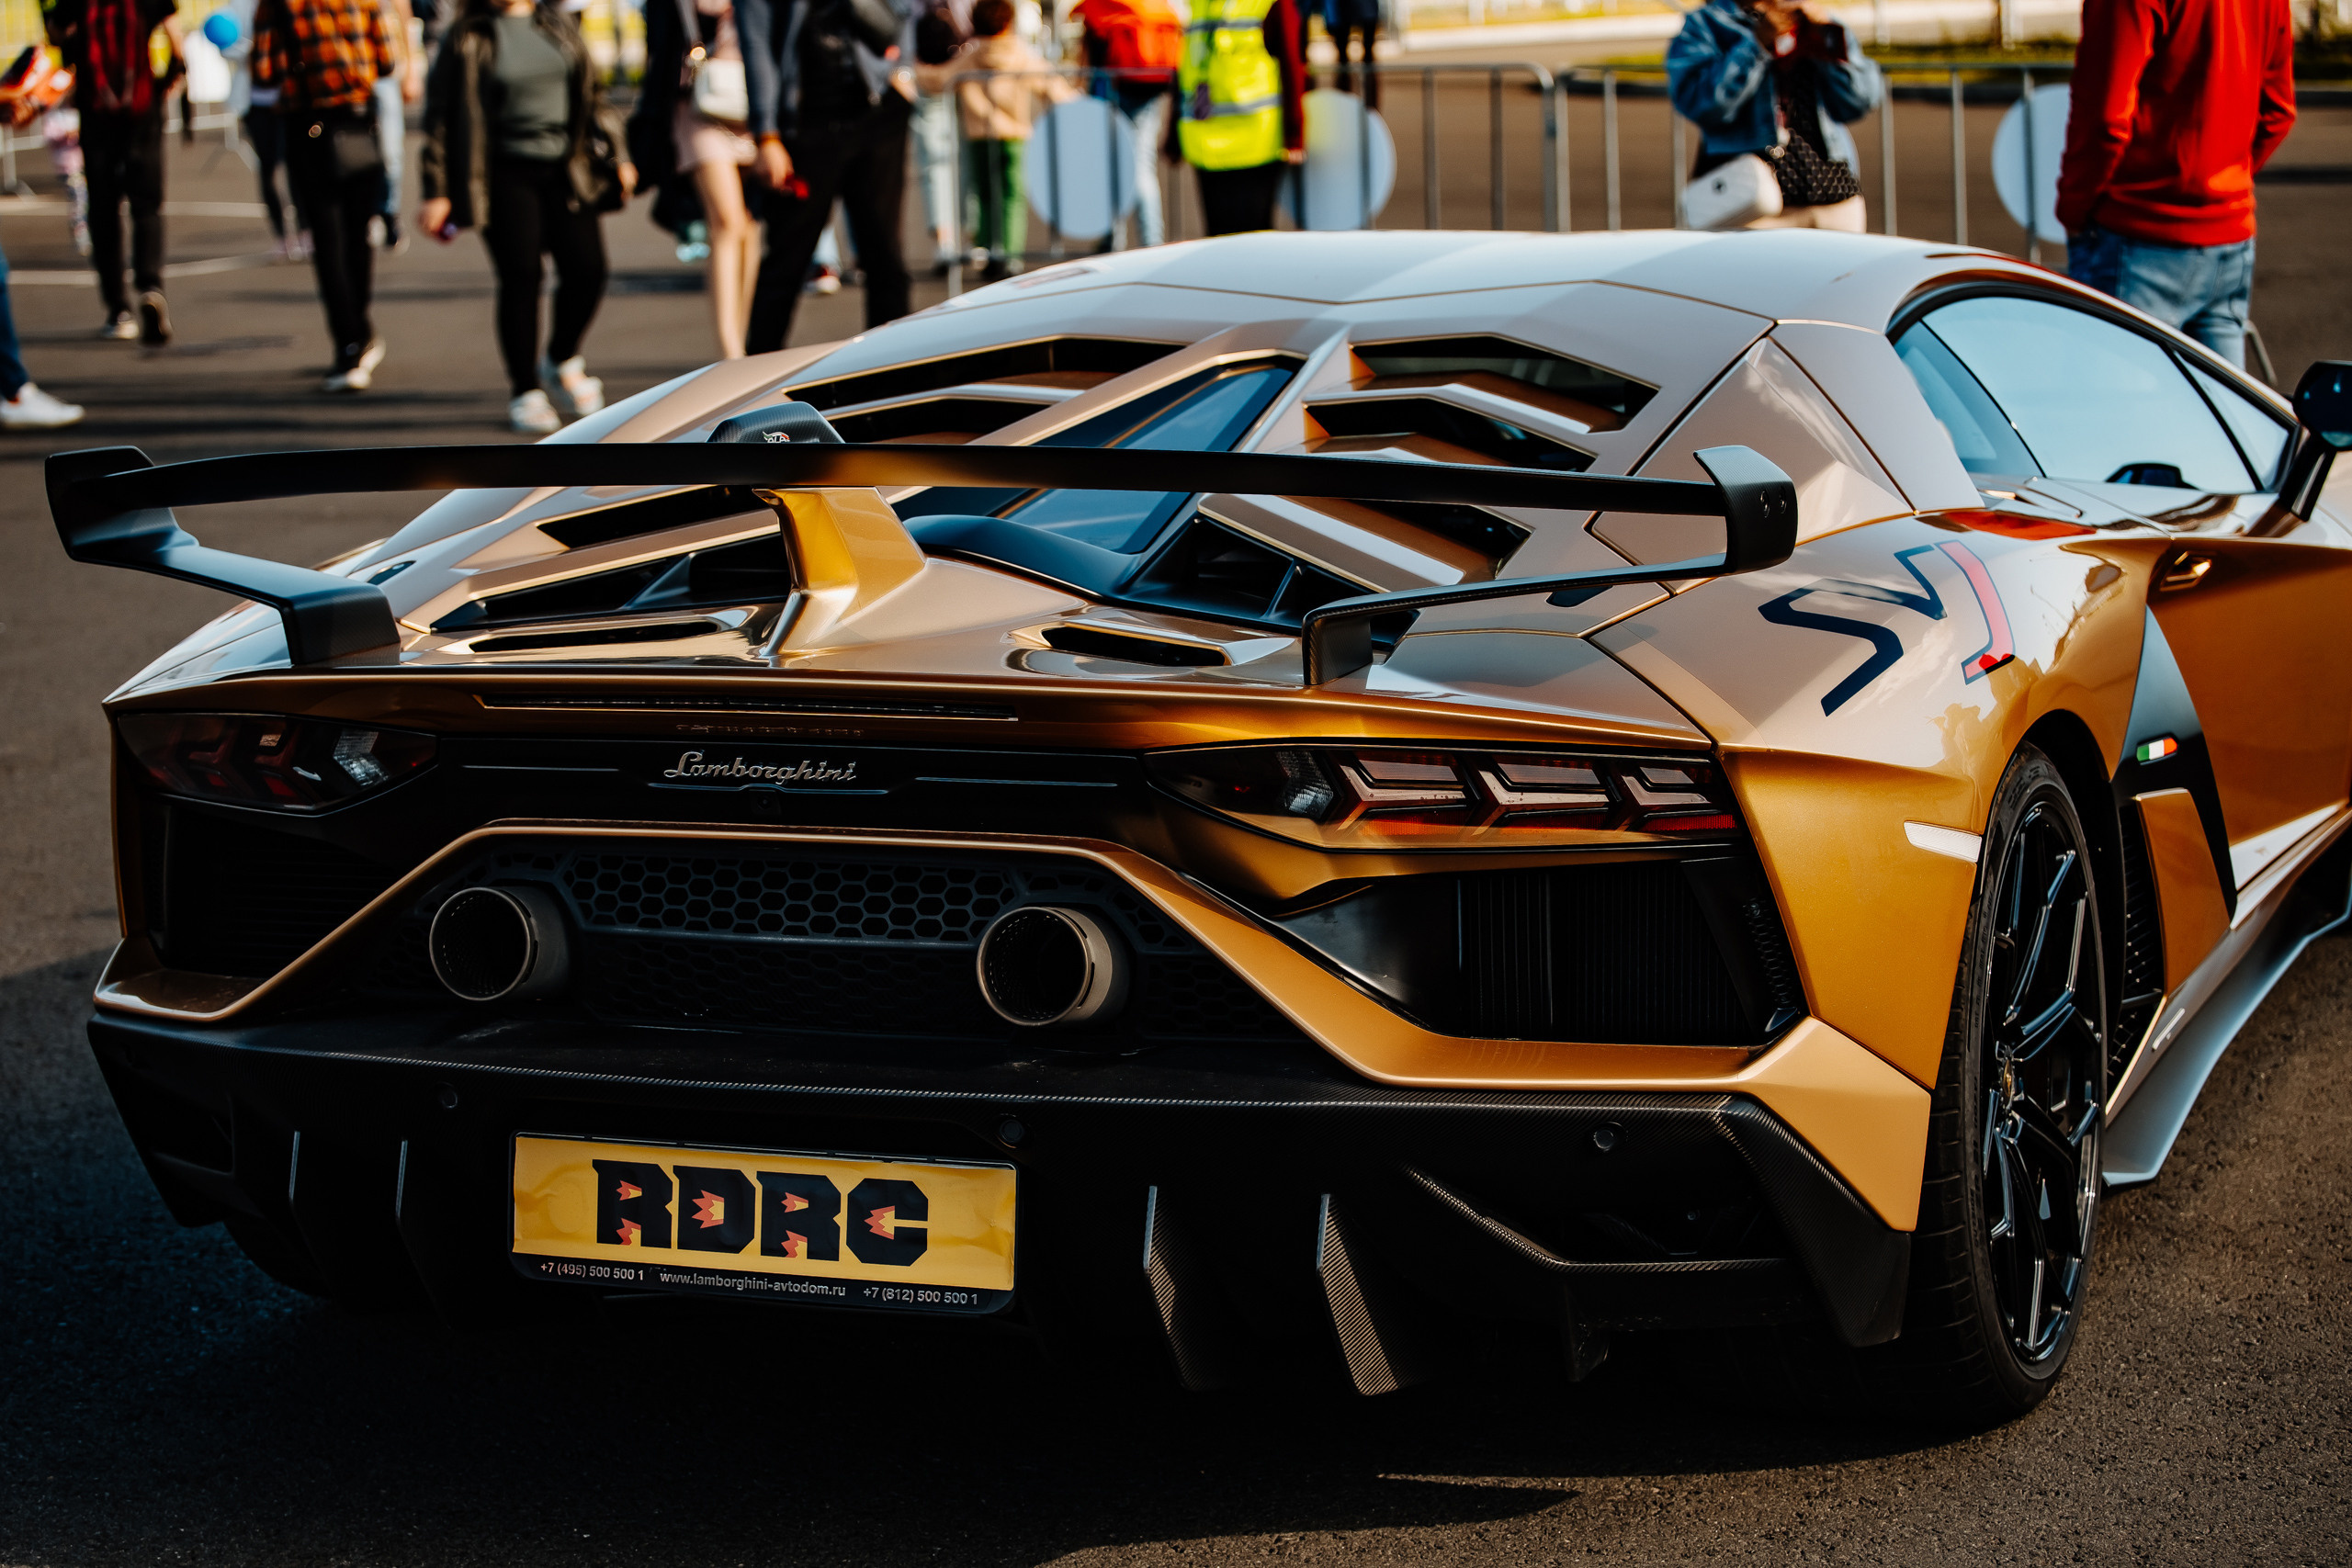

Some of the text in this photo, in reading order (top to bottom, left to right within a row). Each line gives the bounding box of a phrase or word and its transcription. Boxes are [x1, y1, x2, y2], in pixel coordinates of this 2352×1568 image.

[663, 750, 858, 785] Lamborghini
[592, 1158, 930, 1267] RDRC
[540, 1262, 644, 1280] +7 (495) 500 500 1
[660, 1271, 846, 1296] www.lamborghini-avtodom.ru
[864, 1287, 978, 1304] +7 (812) 500 500 1
